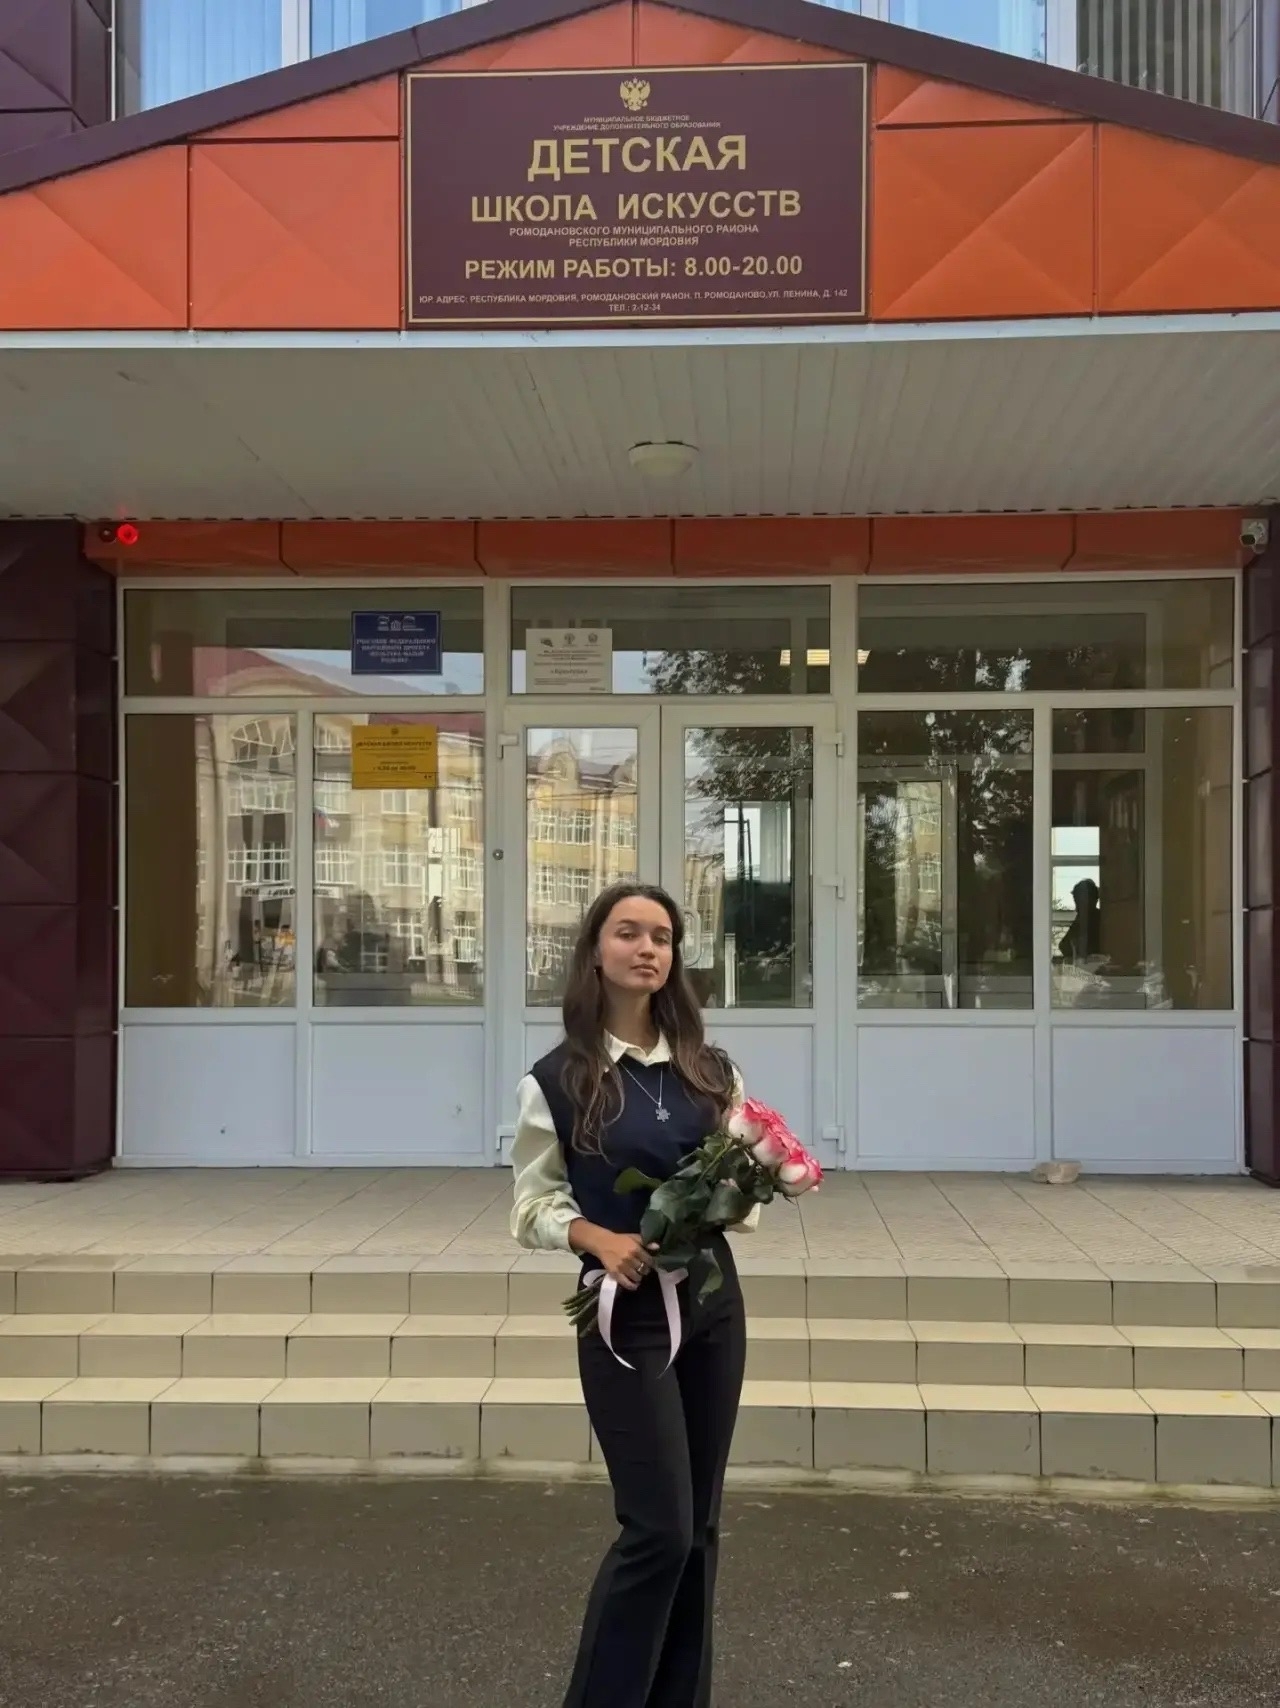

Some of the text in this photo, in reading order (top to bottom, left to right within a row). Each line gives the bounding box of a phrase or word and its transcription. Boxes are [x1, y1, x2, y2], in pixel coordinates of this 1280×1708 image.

[646, 114, 690, 122] БЮДЖЕТНОЕ
[670, 121, 721, 129] ОБРАЗОВАНИЯ
[527, 134, 747, 182] ДЕТСКАЯ
[471, 189, 802, 223] ШКОЛА ИСКУССТВ
[509, 226, 611, 237] РОМОДАНОВСКОГО
[613, 224, 714, 236] МУНИЦИПАЛЬНОГО
[569, 236, 699, 248] РЕСПУБЛИКИ МОРДОВИЯ
[465, 254, 803, 280] РЕЖИМ РАБОТЫ: 8.00-20.00
[470, 294, 527, 304] РЕСПУБЛИКА
[528, 293, 580, 303] МОРДОВИЯ,
[834, 288, 849, 298] 142
